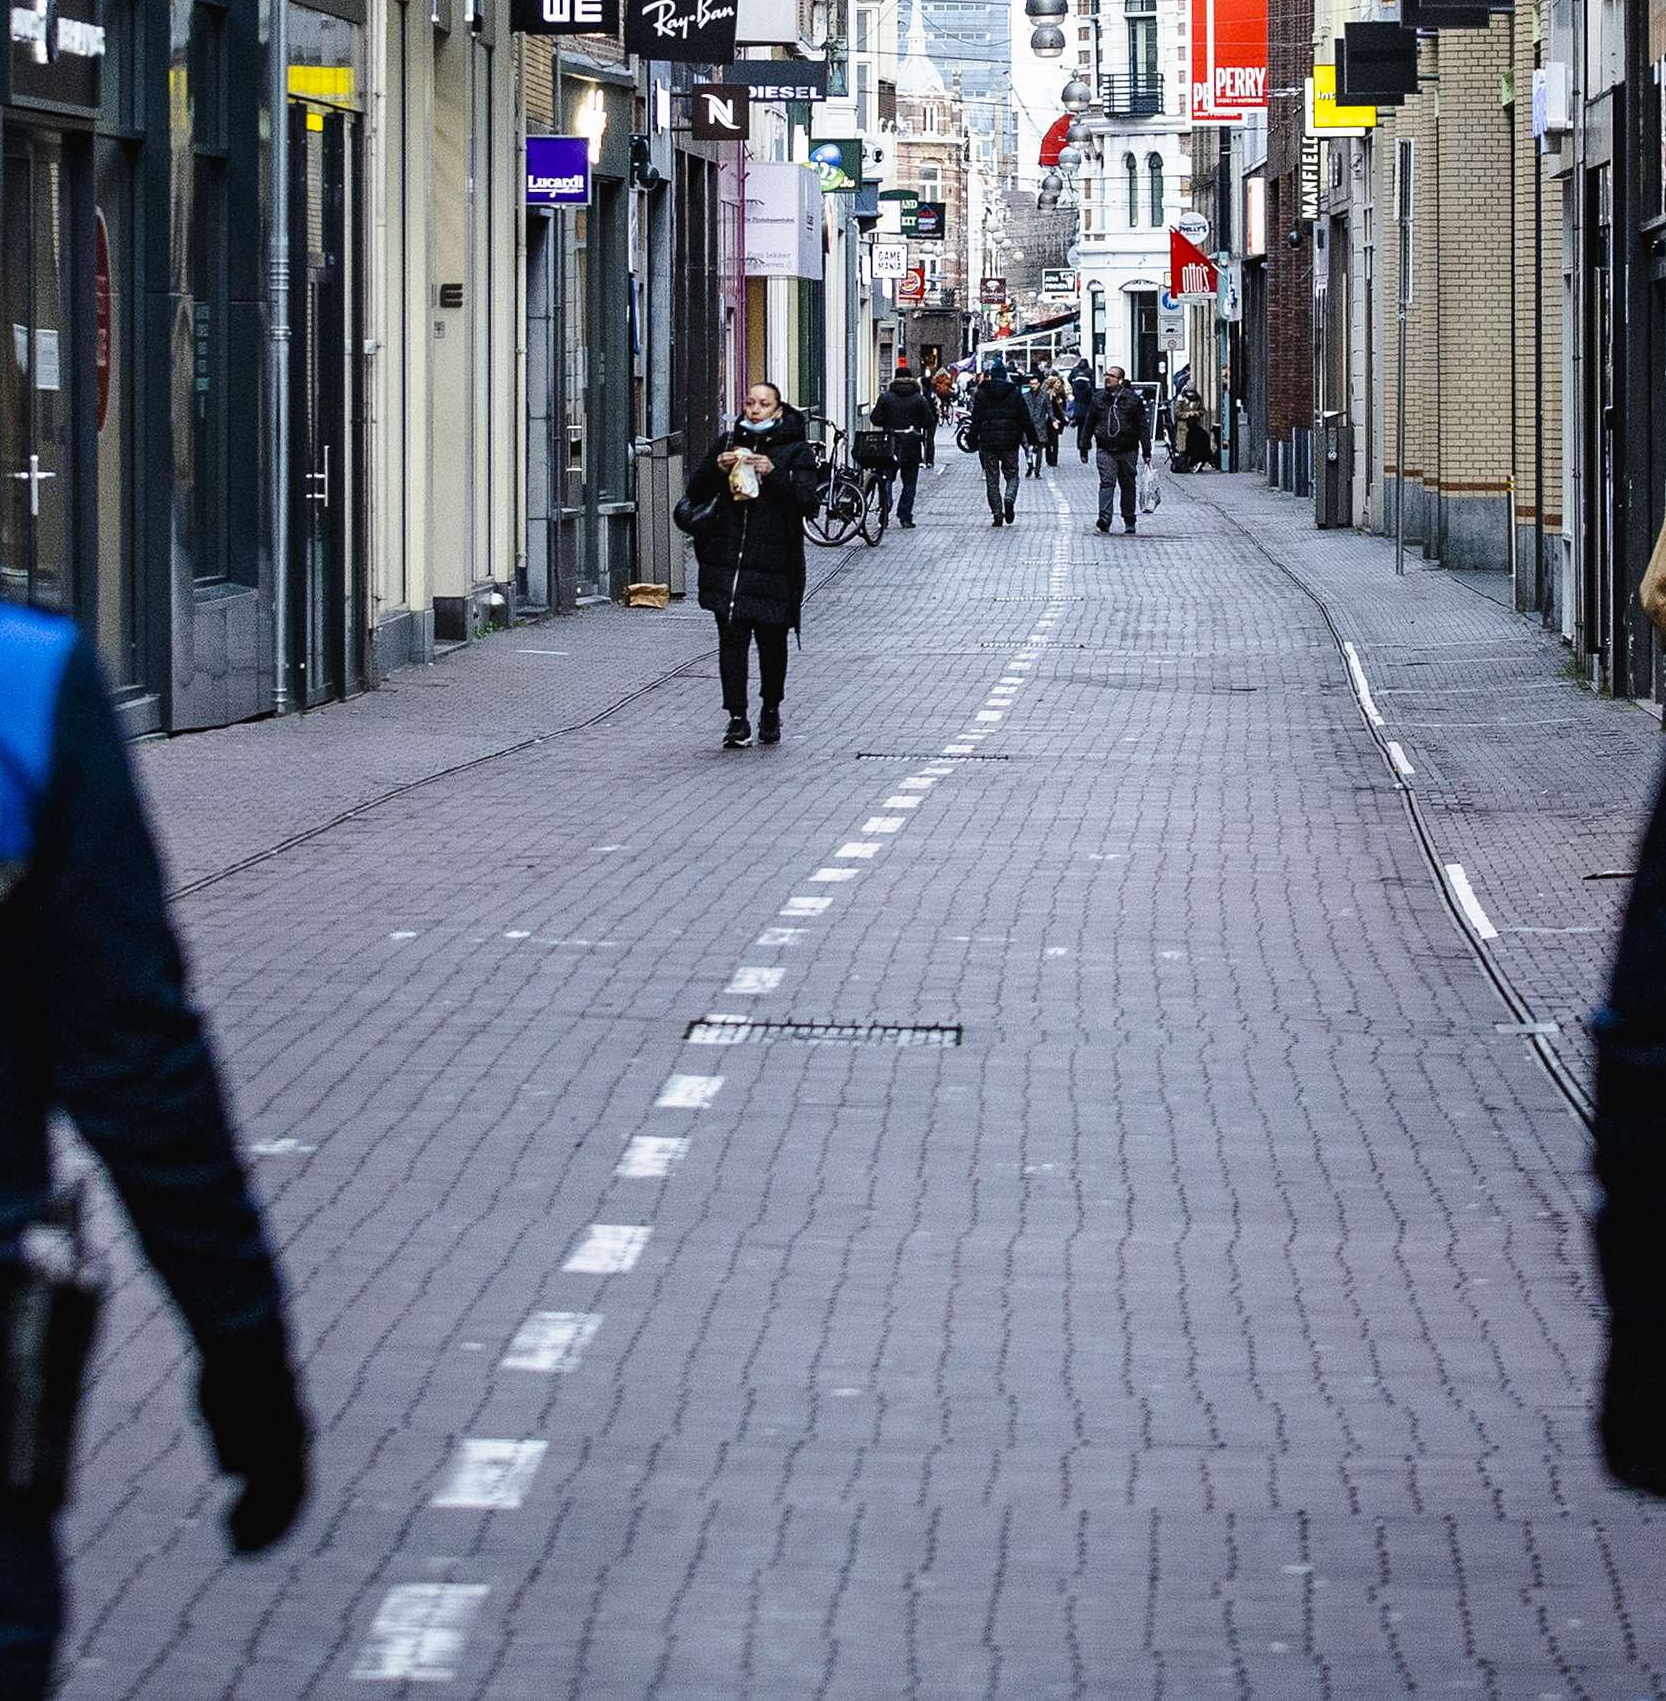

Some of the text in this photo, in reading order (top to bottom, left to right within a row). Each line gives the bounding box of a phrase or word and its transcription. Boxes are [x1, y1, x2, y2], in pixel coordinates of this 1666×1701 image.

[1215, 67, 1266, 98] PERRY
[748, 85, 823, 99] DIESEL
[527, 175, 584, 189] Lucardi
[877, 251, 901, 262] GAME
[877, 262, 902, 272] MANIA
